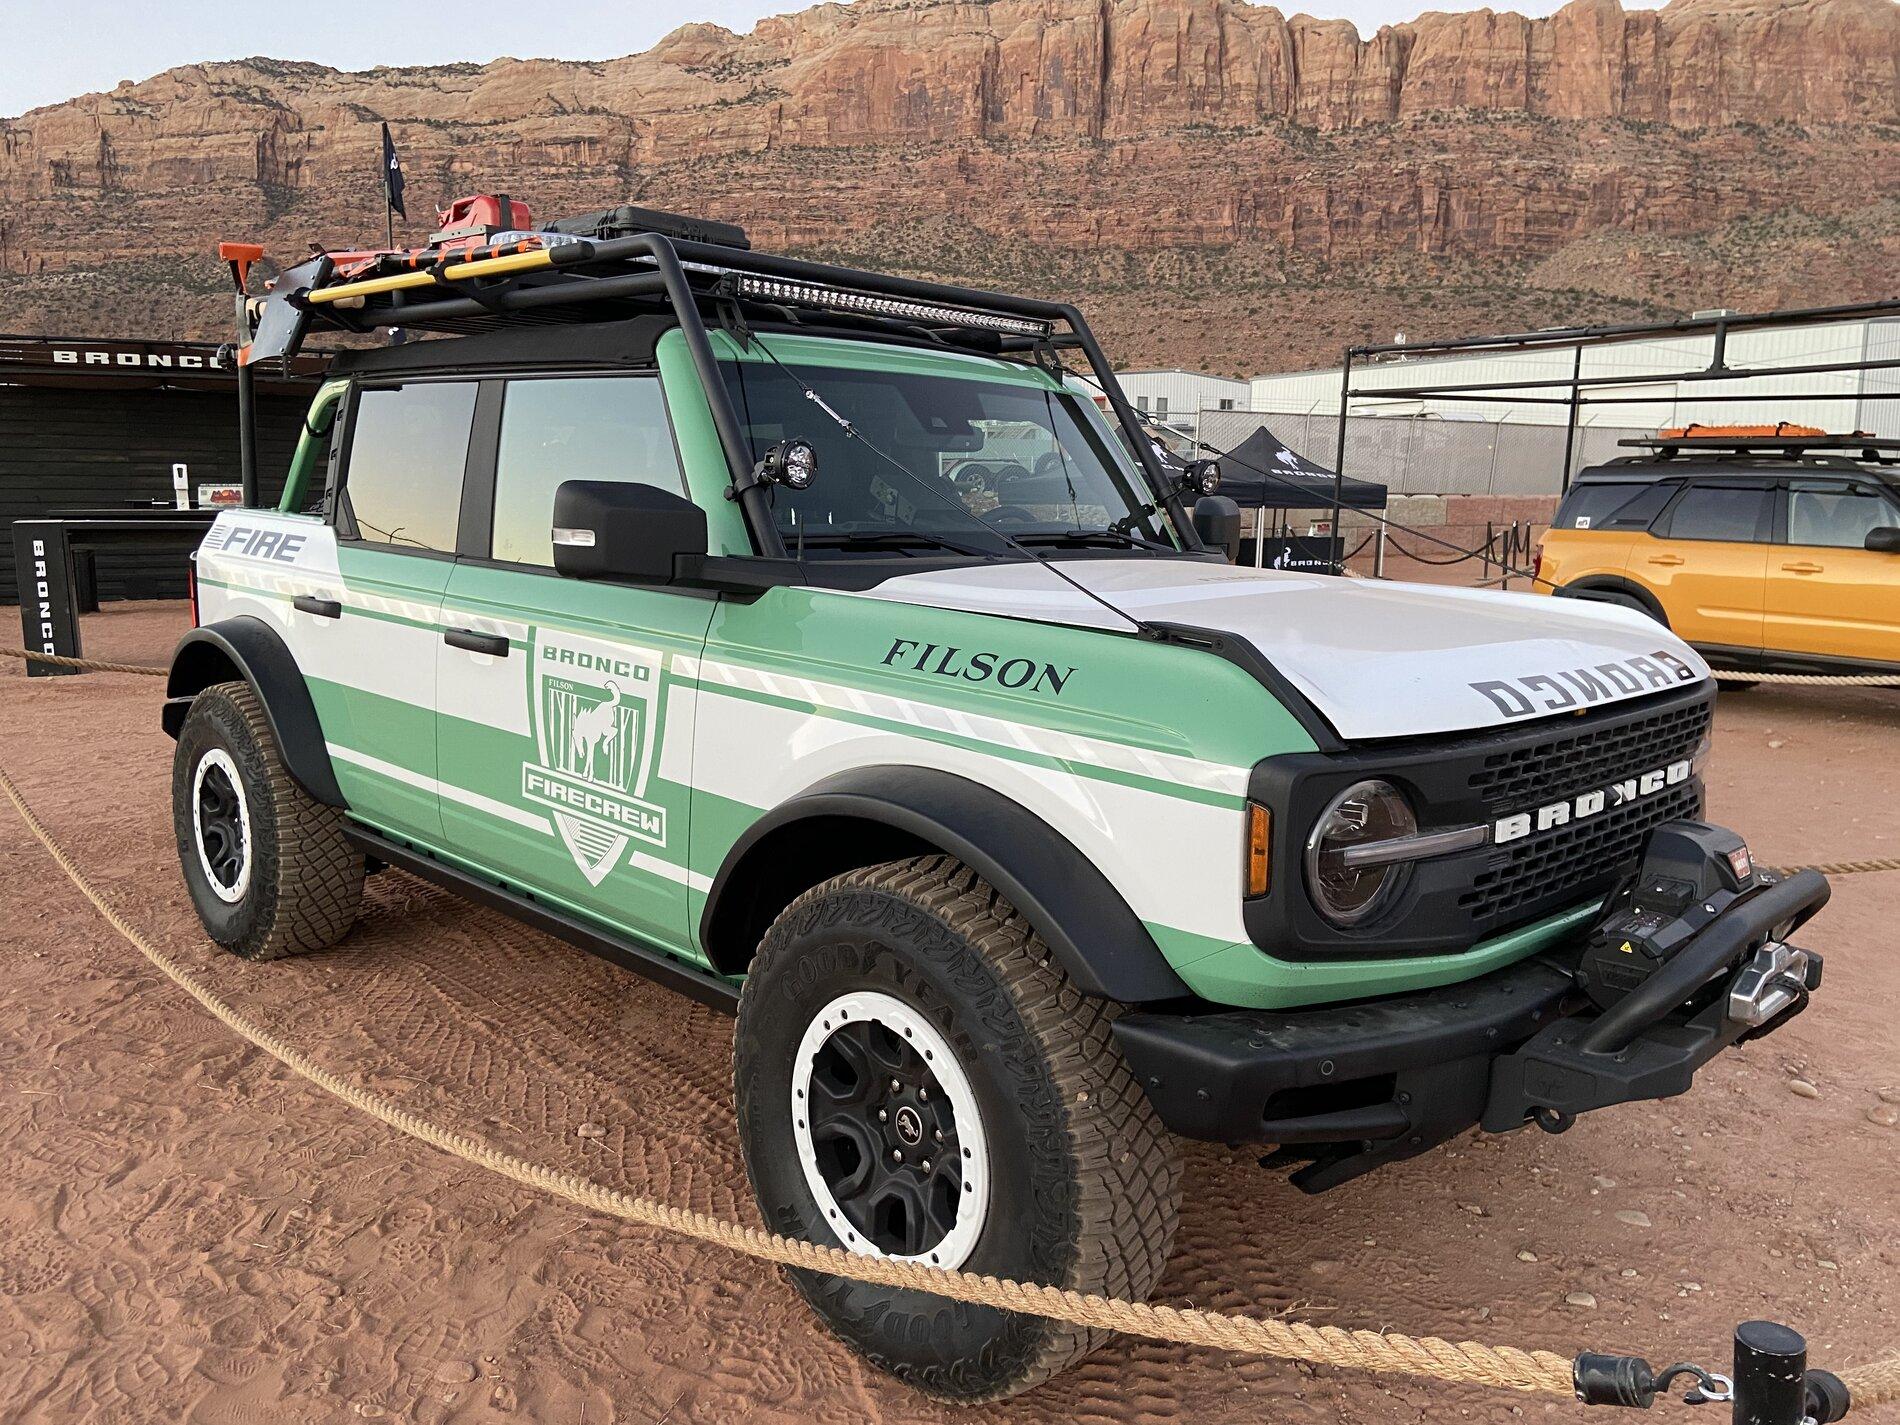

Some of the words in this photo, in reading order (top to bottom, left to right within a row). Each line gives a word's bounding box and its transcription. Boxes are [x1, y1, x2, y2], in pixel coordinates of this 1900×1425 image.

[221, 526, 308, 563] FIRE
[1290, 559, 1333, 567] BRON
[33, 540, 55, 656] BRONCO
[543, 646, 650, 682] BRONCO
[548, 678, 575, 691] FILSON
[879, 638, 1079, 696] FILSON
[527, 773, 660, 836] FIRECREW
[1494, 758, 1692, 844] BRONCO
